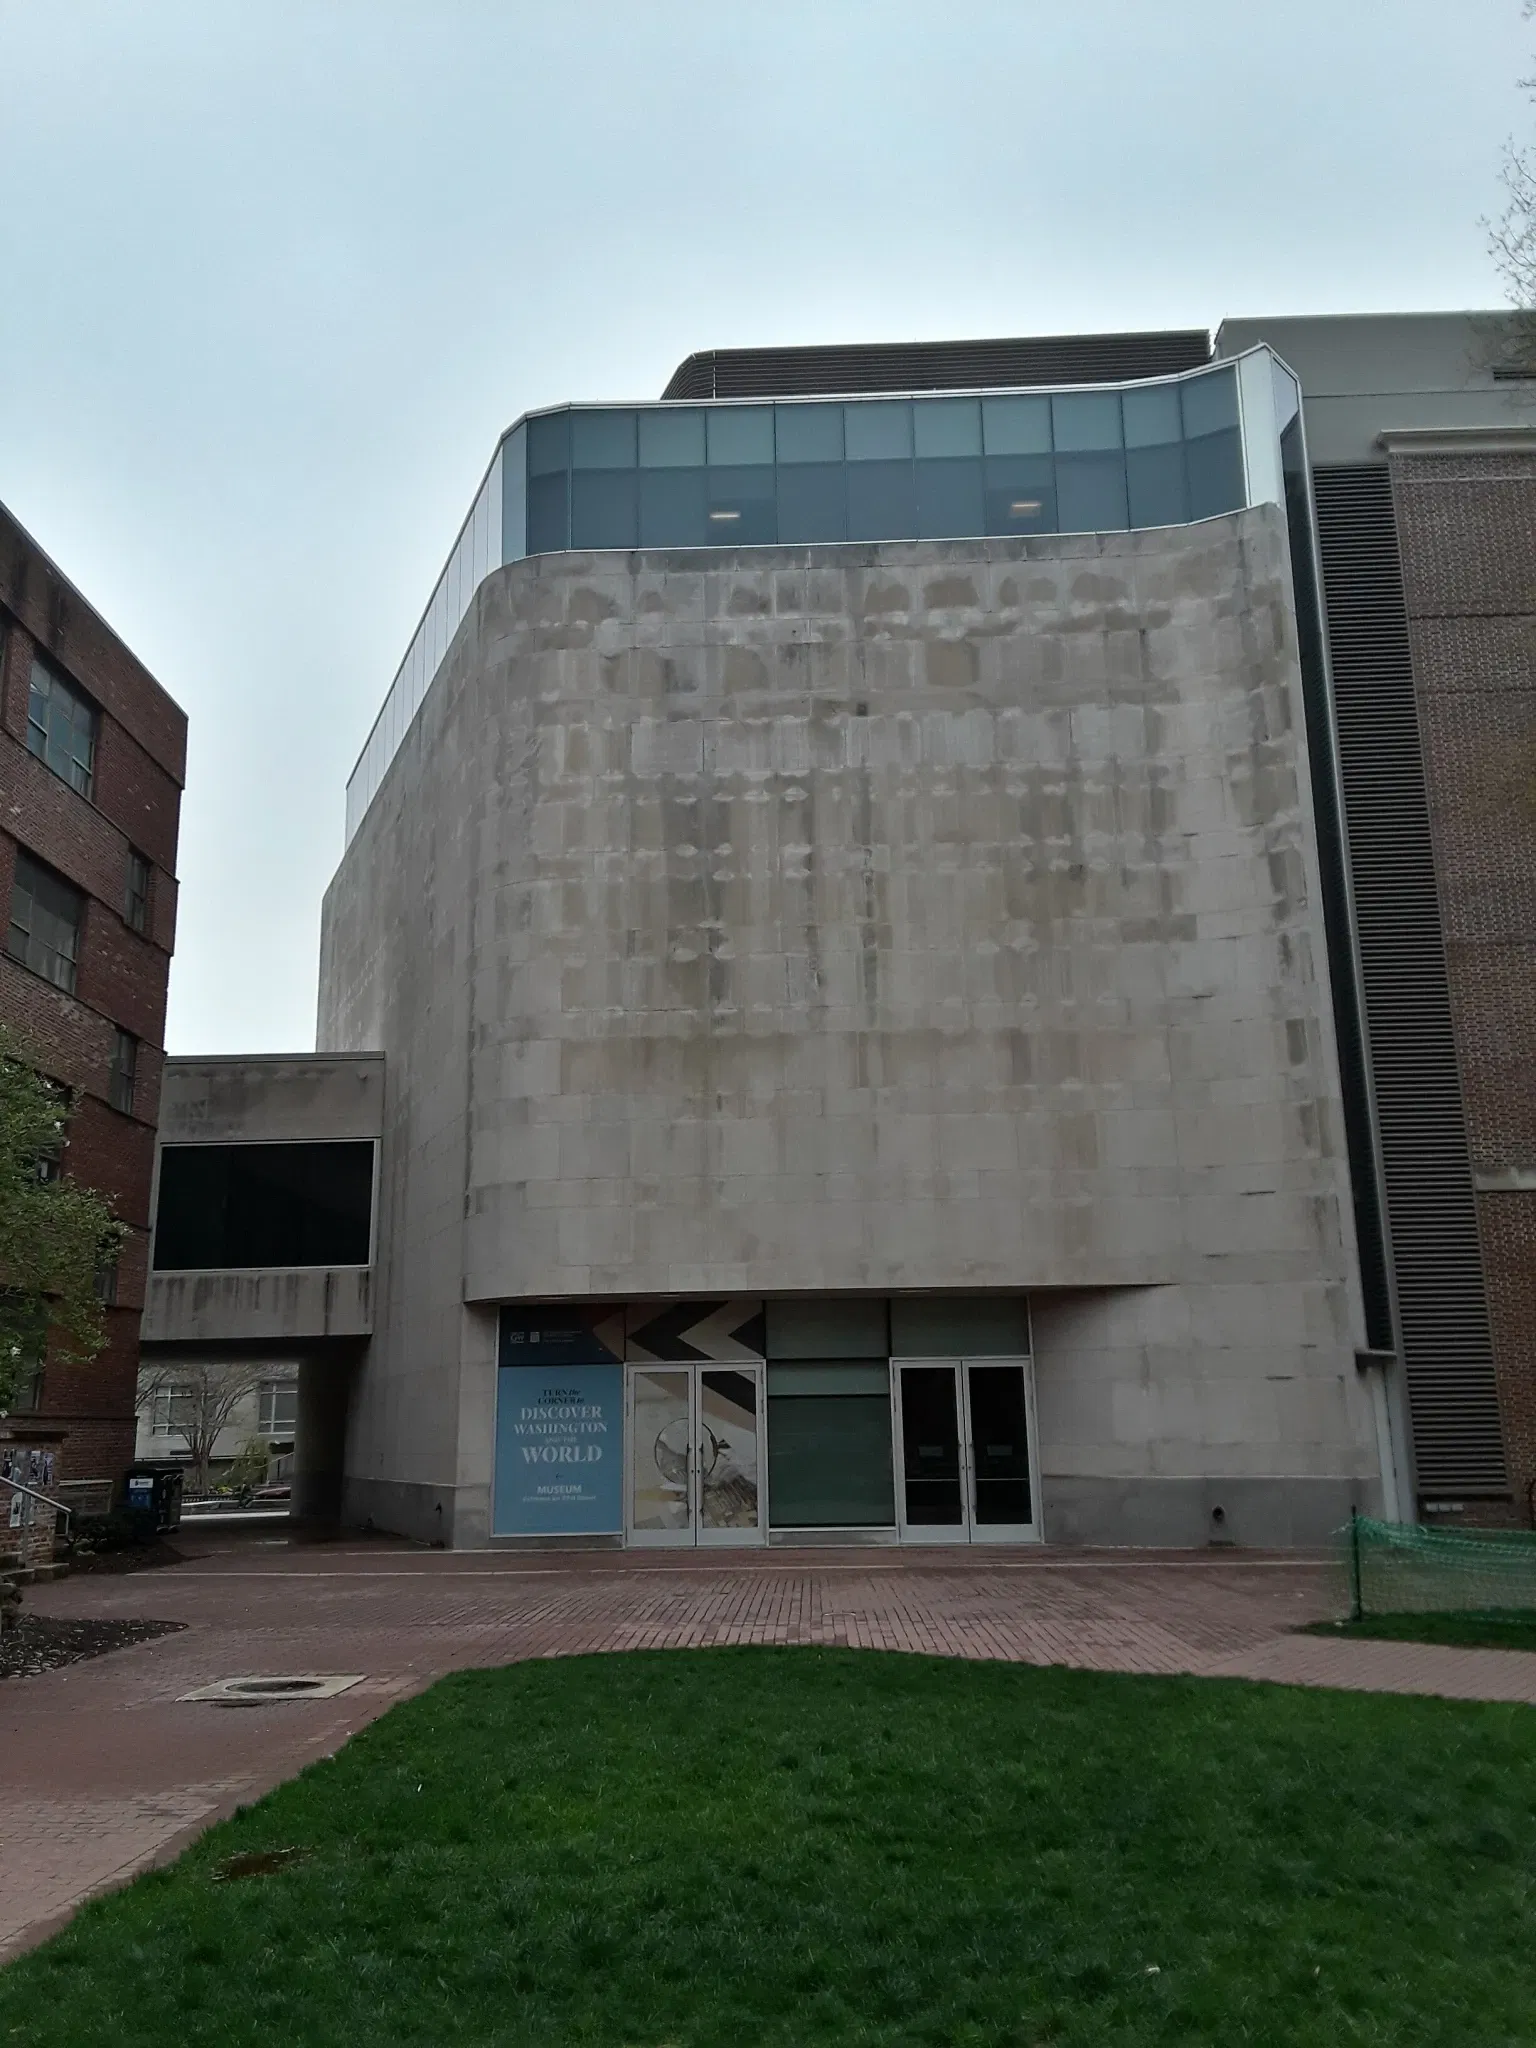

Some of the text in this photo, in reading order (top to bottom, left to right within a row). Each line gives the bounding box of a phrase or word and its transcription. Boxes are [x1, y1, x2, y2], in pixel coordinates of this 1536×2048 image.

[521, 1406, 602, 1420] DISCOVER
[514, 1422, 607, 1434] WASHINGTON
[522, 1445, 602, 1464] WORLD
[537, 1484, 582, 1495] MUSEUM
